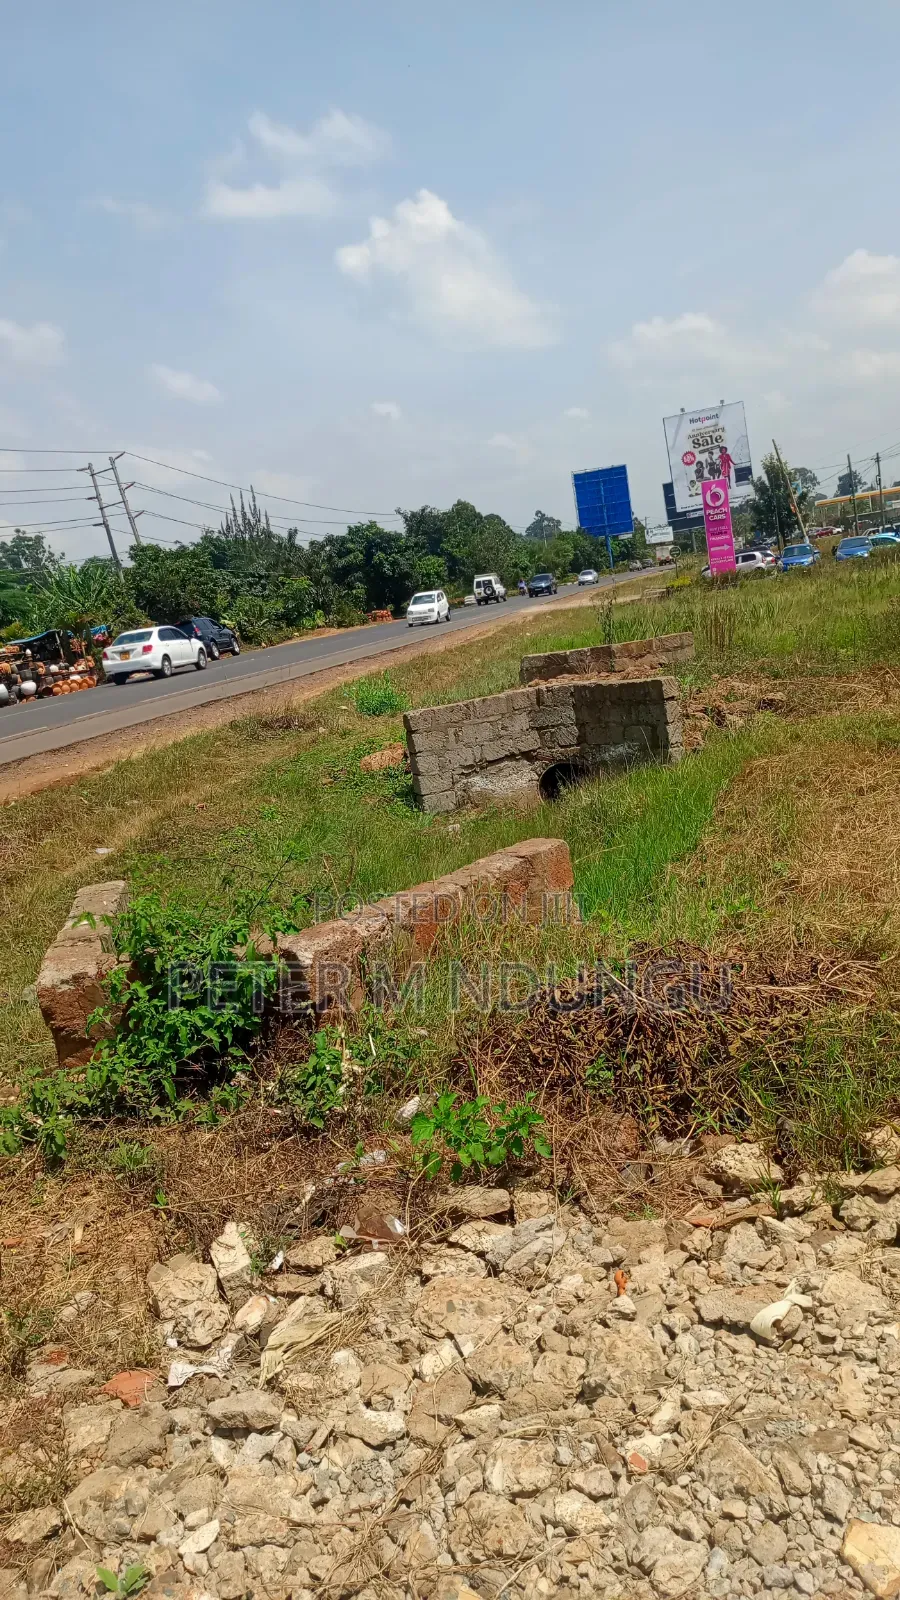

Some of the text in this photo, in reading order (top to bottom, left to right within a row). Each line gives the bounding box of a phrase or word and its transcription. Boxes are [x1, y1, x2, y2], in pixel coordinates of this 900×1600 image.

[689, 413, 720, 424] Hotpoint
[687, 426, 725, 439] Anniversary
[692, 435, 724, 449] Sale
[706, 507, 728, 515] PEACH
